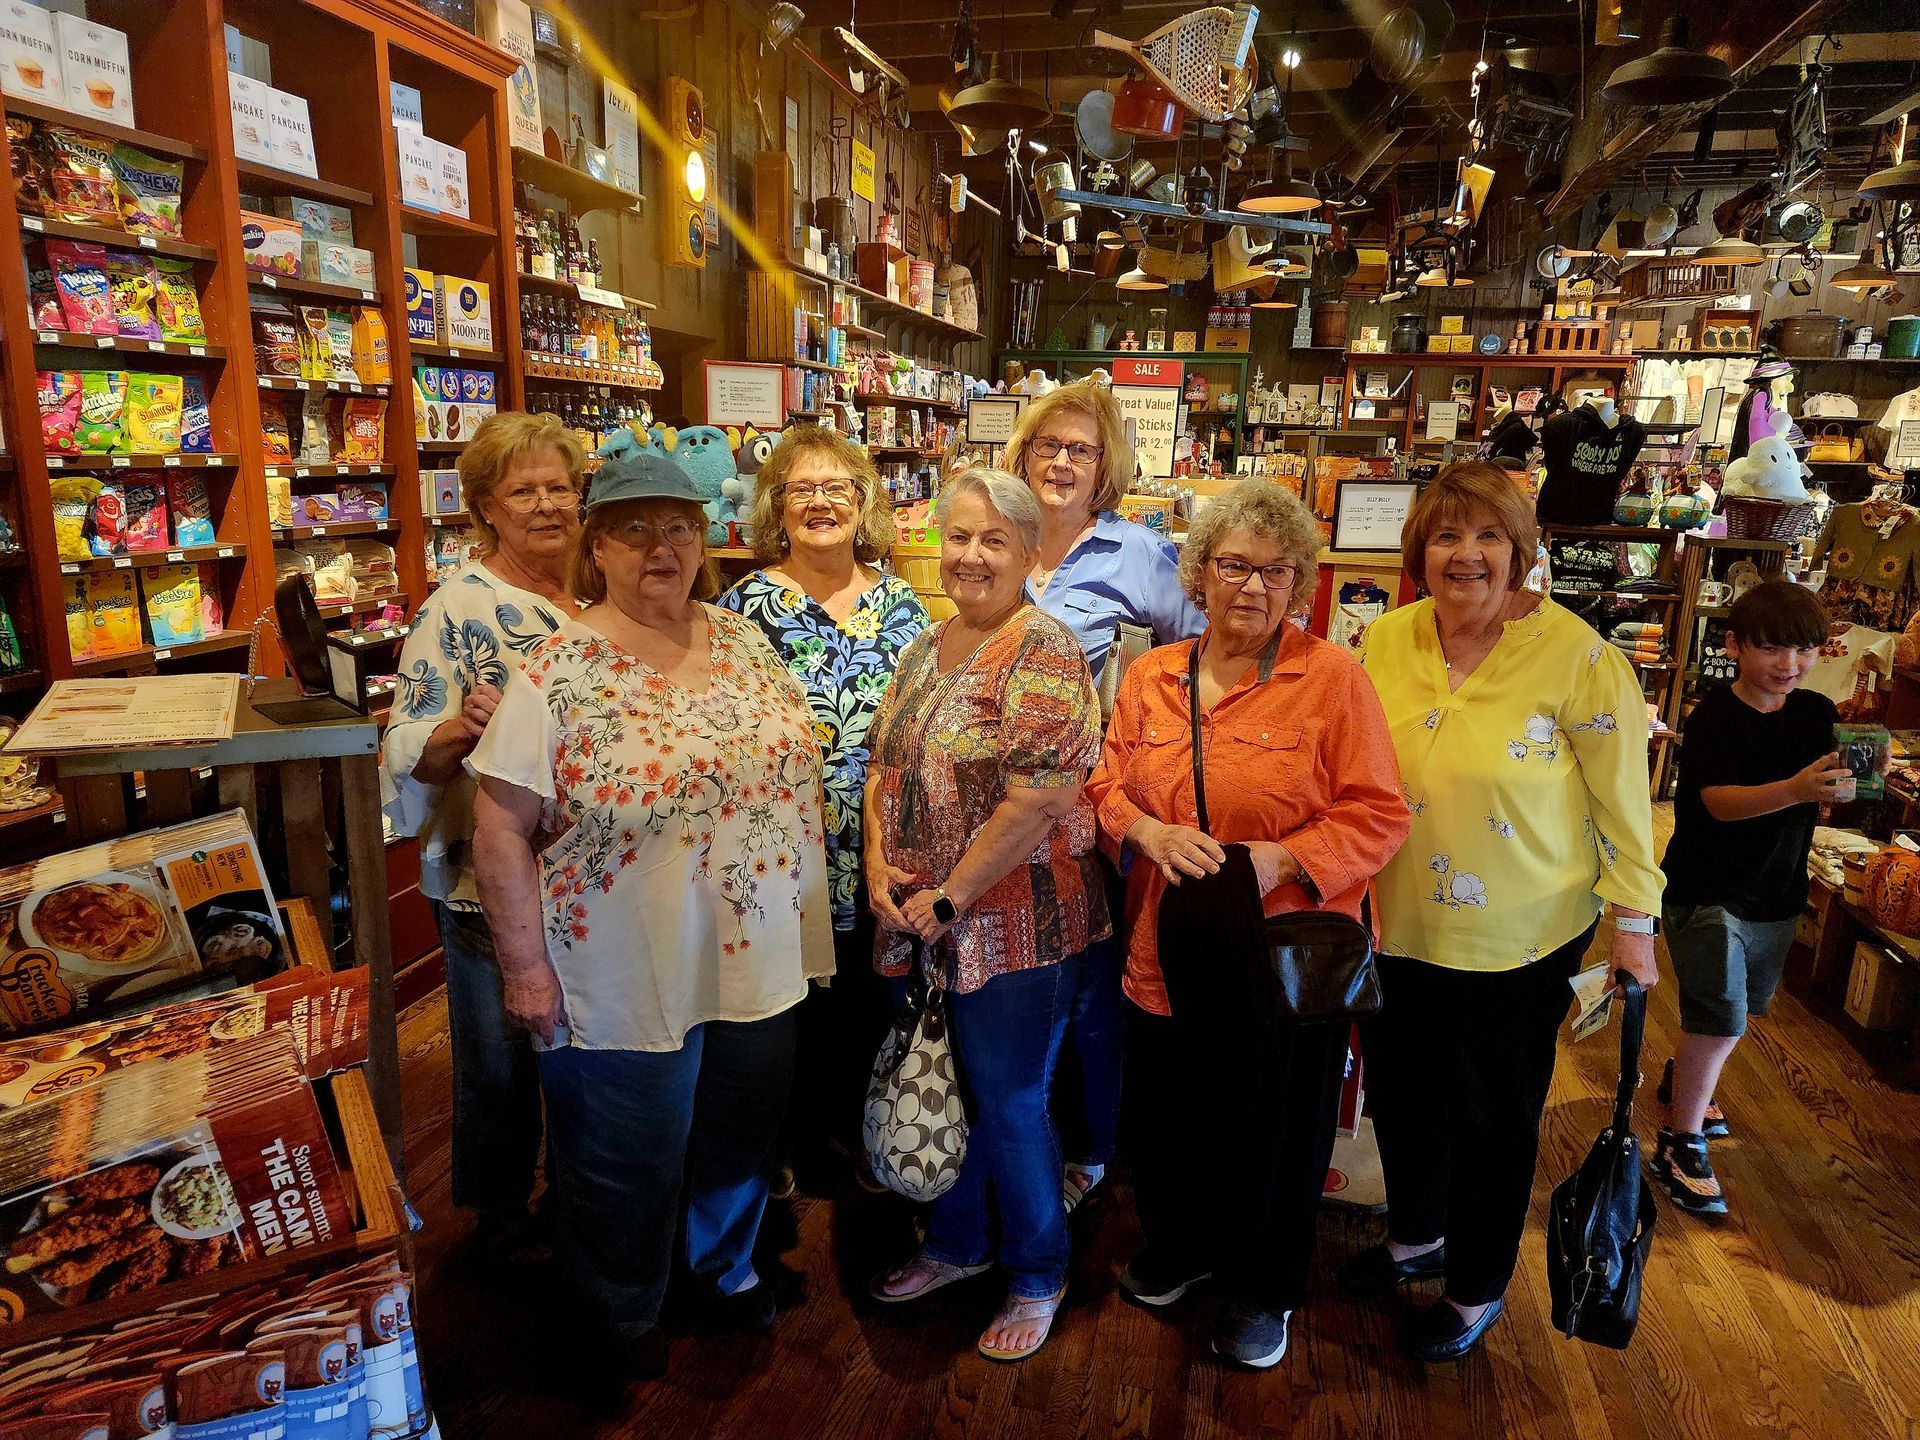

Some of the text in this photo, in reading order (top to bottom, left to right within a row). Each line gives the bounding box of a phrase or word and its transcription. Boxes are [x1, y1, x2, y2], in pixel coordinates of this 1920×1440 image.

[0, 27, 53, 54] ORN MUFFIN
[68, 49, 126, 75] CORN MUFFIN
[232, 100, 265, 120] ANCAKE
[392, 105, 418, 121] ANCAKE
[271, 113, 307, 133] PANCAKE
[515, 114, 540, 135] QUEEN
[405, 153, 433, 171] PANCAKE
[243, 229, 265, 241] unkist
[275, 332, 293, 343] Roll
[450, 322, 491, 340] MOON PIE
[1134, 363, 1160, 376] SALE
[82, 392, 123, 412] kittles
[1145, 399, 1175, 411] Value!
[1138, 418, 1173, 431] Sticks
[310, 552, 338, 561] OFFEE
[315, 558, 344, 568] UARES
[1575, 581, 1588, 590] ARE
[1711, 658, 1726, 666] BOO
[216, 852, 228, 867] NEW
[235, 847, 246, 859] TRY
[225, 850, 244, 883] SOMETHING
[0, 966, 50, 1023] Barrel
[14, 953, 59, 1017] Cracker
[292, 995, 309, 1016] THE
[311, 996, 326, 1057] Savor summer with
[331, 988, 354, 1048] Savor summer with
[261, 1137, 316, 1249] THE CAM
[292, 1144, 333, 1242] Savor summe
[249, 1198, 288, 1257] MEN
